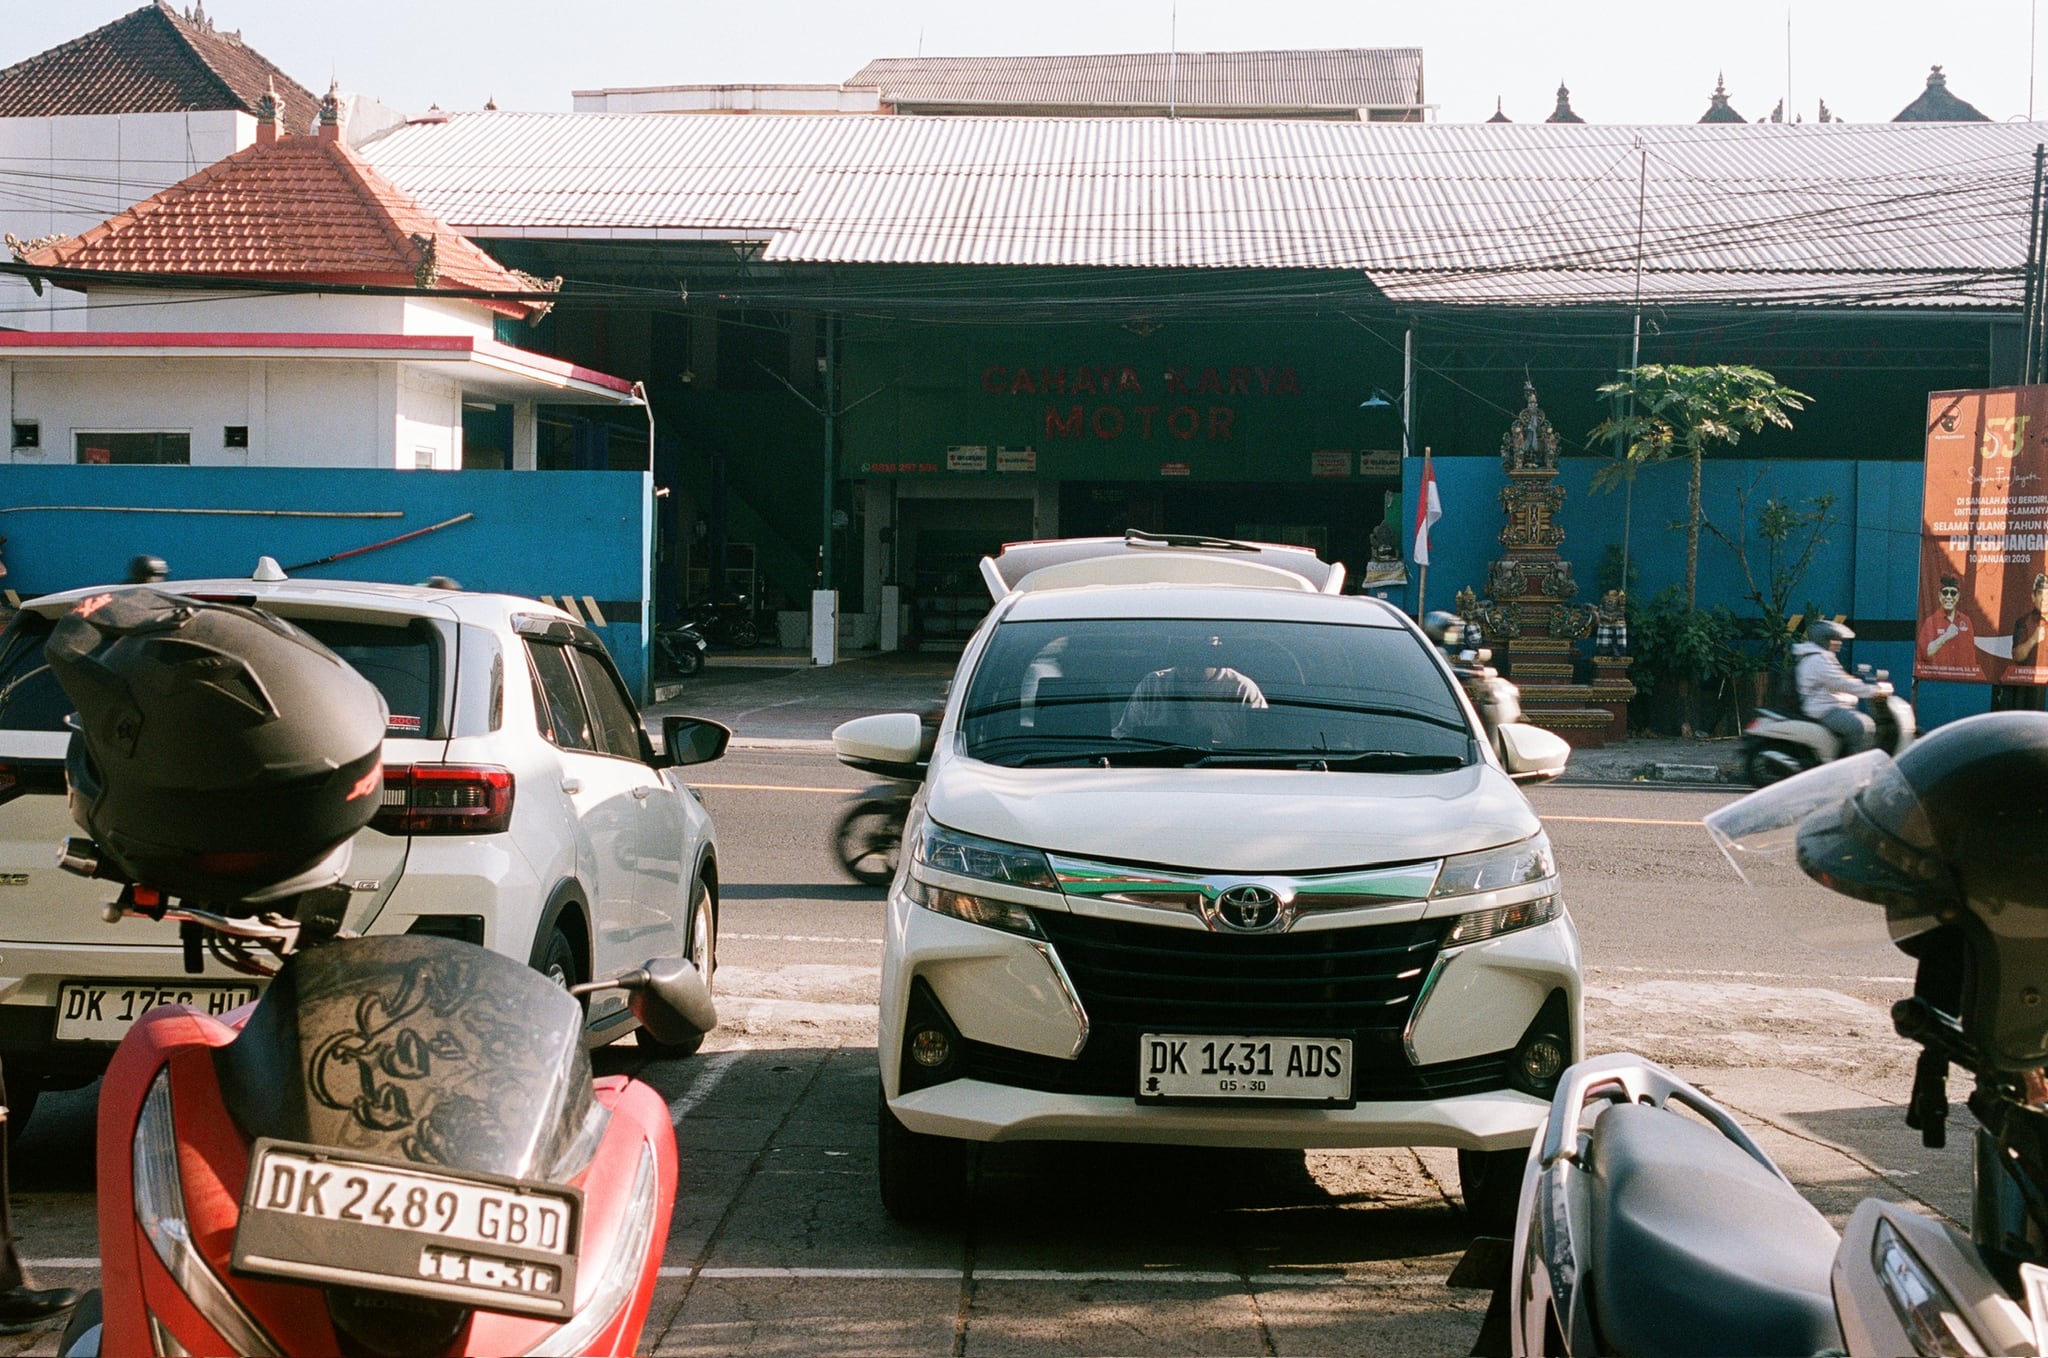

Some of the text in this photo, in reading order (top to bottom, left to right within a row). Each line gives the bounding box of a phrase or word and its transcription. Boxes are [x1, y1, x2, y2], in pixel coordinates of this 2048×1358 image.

[981, 363, 1304, 397] CAHAYA KARYA
[1044, 403, 1237, 442] MOTOR
[1980, 415, 2031, 459] 53
[1954, 507, 1979, 516] UNTUK
[2001, 496, 2018, 505] AKU
[1934, 521, 1974, 531] SELAMAT
[1976, 521, 2006, 531] ULANG
[2008, 520, 2041, 530] TAHUN
[1949, 534, 1970, 551] PDI
[1977, 554, 2011, 563] JANUARI
[2012, 554, 2030, 563] 2026
[65, 988, 106, 1021] DK
[1150, 1041, 1342, 1078] DK 1431 ADS
[267, 1163, 561, 1250] DK 2489 GBD
